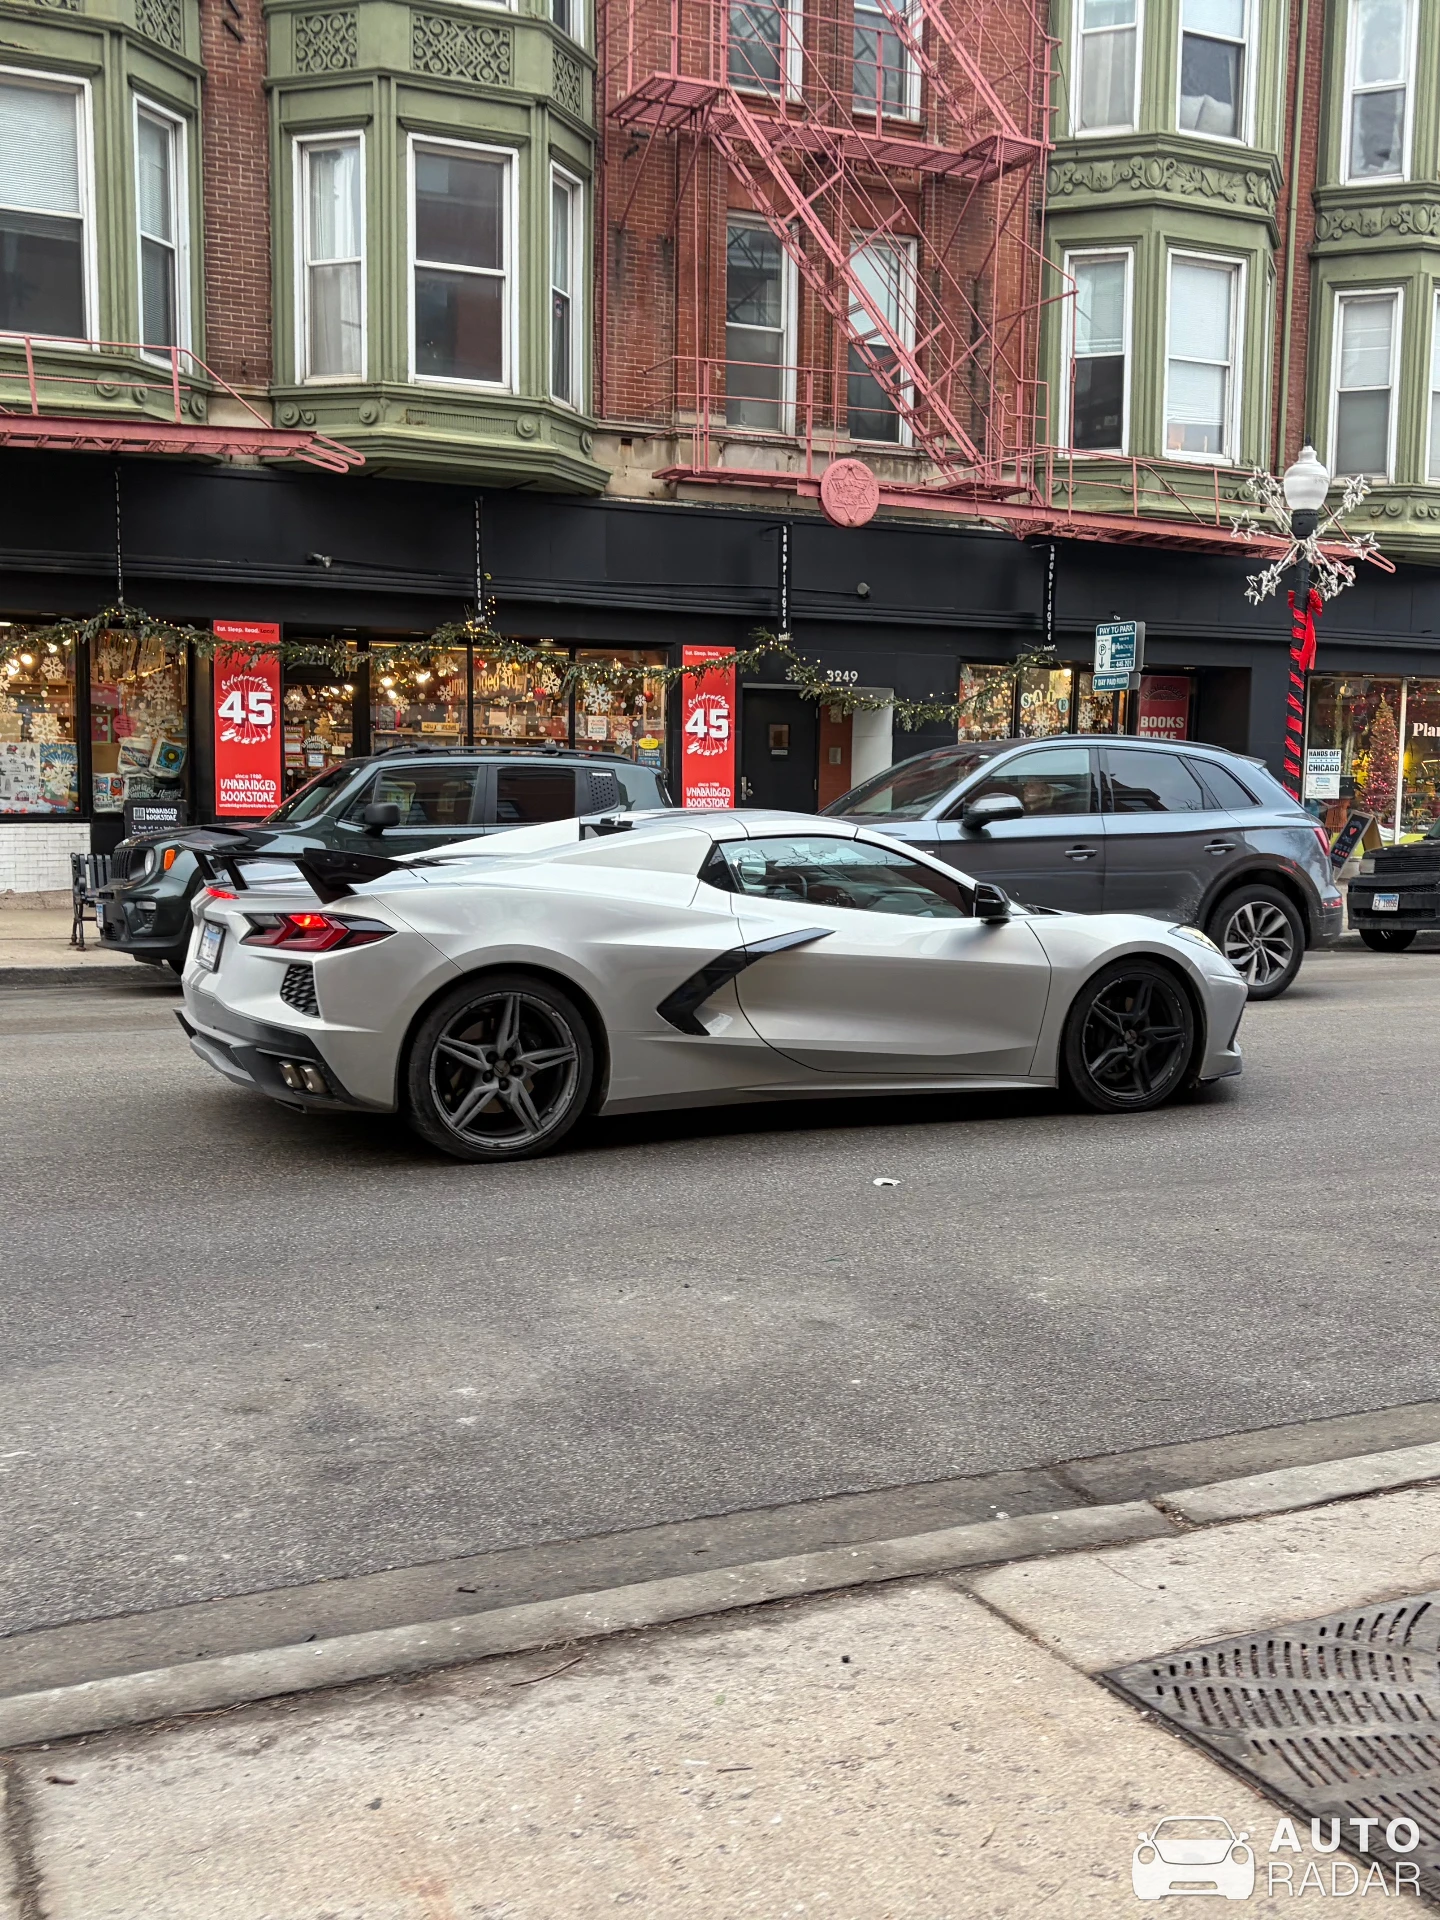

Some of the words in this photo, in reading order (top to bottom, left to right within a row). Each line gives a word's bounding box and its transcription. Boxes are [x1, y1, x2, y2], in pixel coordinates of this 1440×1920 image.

[1099, 627, 1111, 636] PAY
[1111, 625, 1119, 634] TO
[1119, 624, 1134, 633] PARK
[221, 674, 274, 692] Celebrating
[827, 670, 859, 683] 3249
[1097, 678, 1106, 687] DAY
[1106, 677, 1117, 686] PAID
[217, 690, 274, 725] 45
[1023, 691, 1067, 711] SALE
[685, 708, 729, 739] 45
[1140, 715, 1185, 729] BOOKS
[220, 725, 272, 744] Years!
[686, 738, 728, 757] Years!
[1308, 764, 1340, 772] CHICAGO
[220, 778, 277, 791] UNABRIDGED
[220, 790, 275, 803] BOOKSTORE
[686, 787, 731, 797] UNABRIDGED
[686, 797, 730, 808] BOOKSTORE
